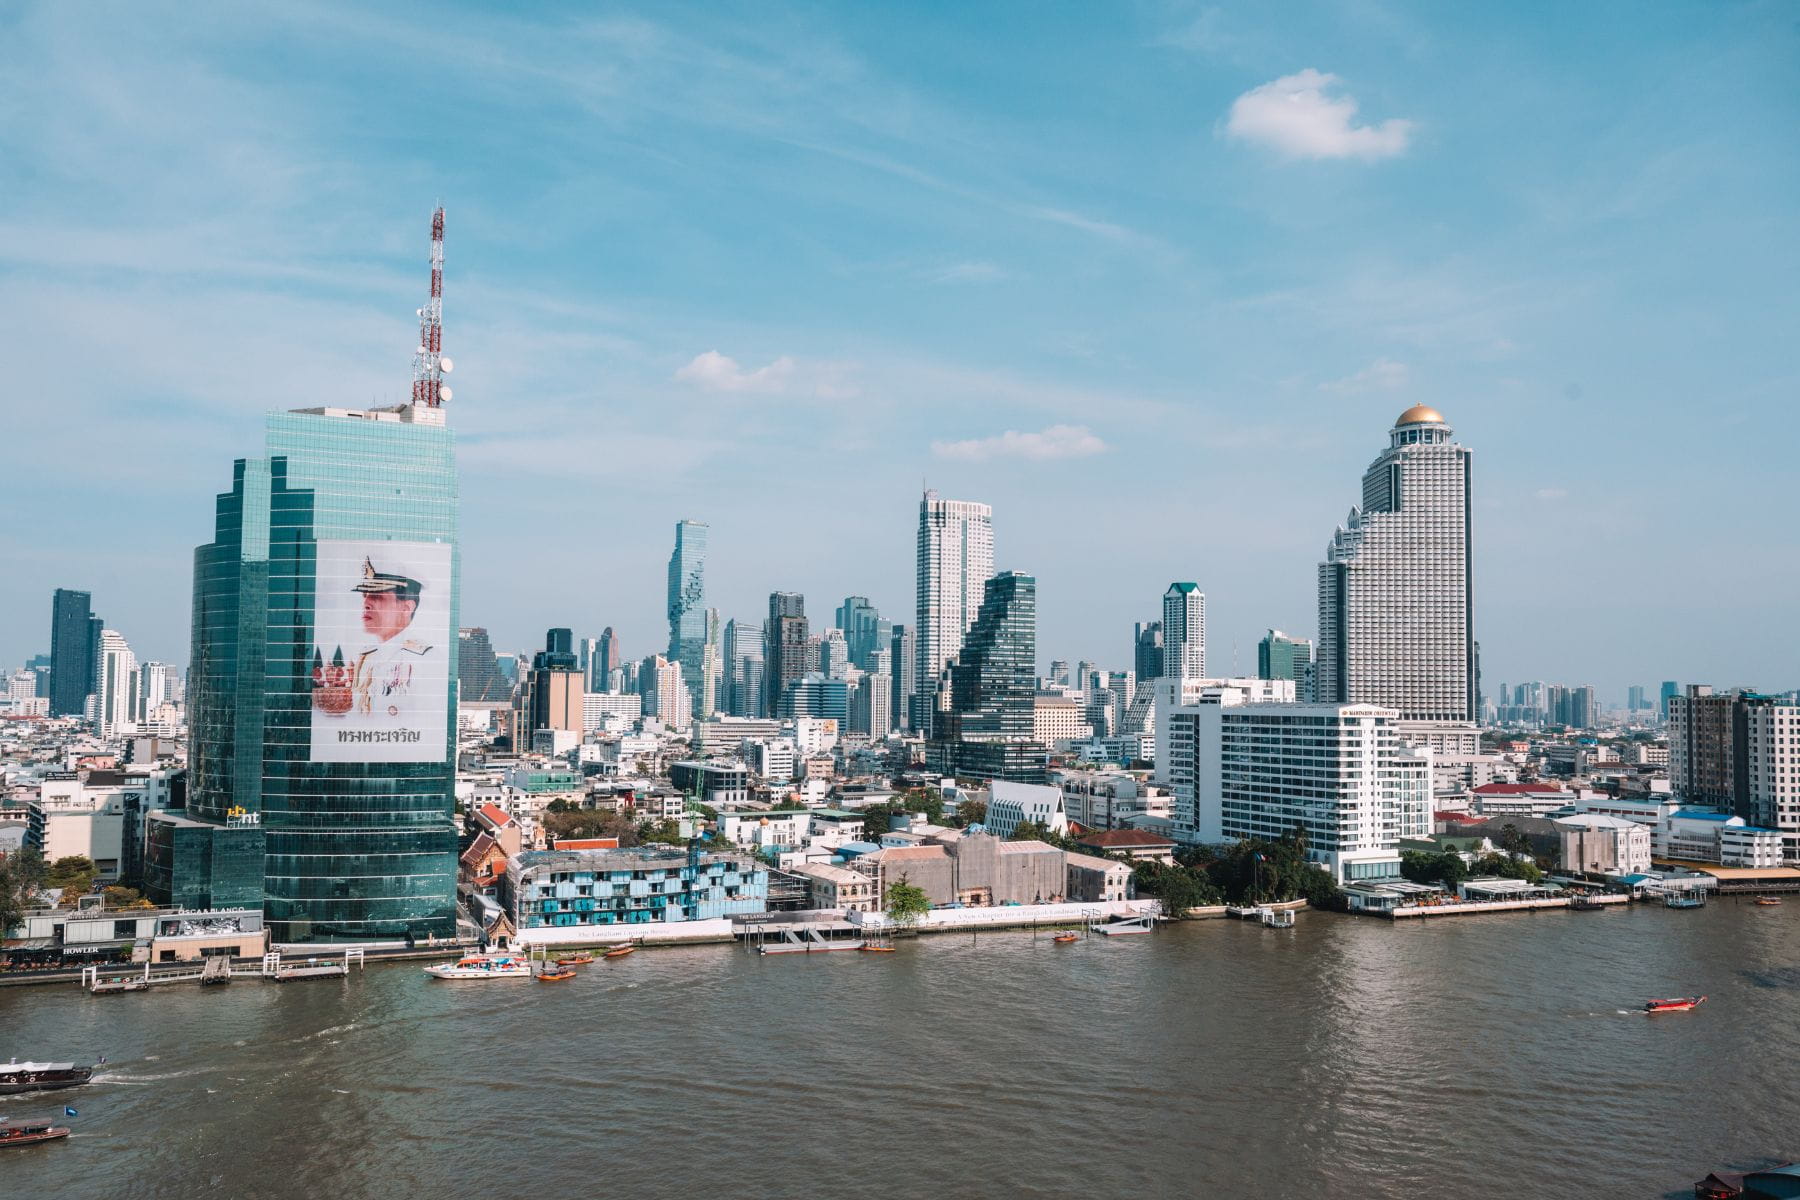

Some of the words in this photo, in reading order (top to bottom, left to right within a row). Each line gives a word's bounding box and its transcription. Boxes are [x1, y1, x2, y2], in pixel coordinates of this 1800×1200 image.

[337, 727, 421, 743] ทรงพระเจริญ
[63, 947, 99, 955] HOWLER
